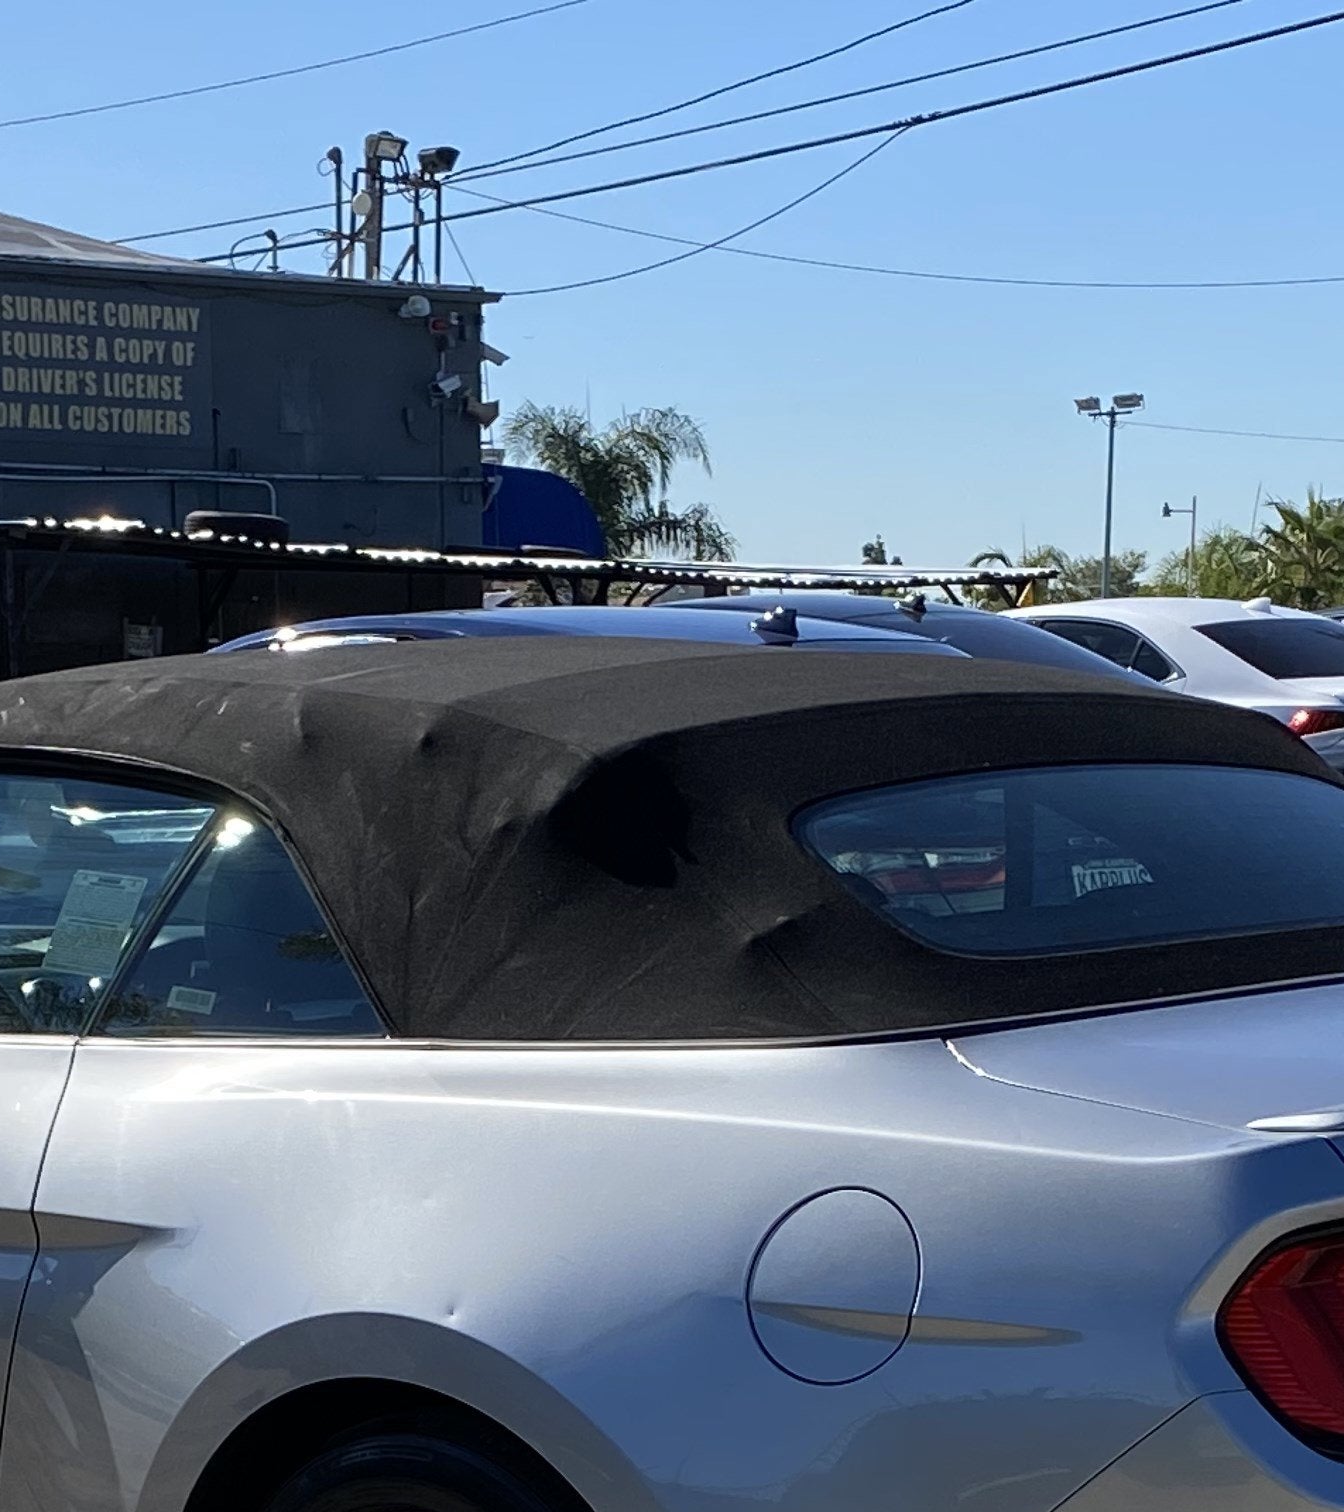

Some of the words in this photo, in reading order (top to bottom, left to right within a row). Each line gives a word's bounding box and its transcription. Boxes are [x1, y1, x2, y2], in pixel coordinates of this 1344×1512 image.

[104, 302, 200, 332] COMPANY
[95, 337, 107, 362] A
[113, 337, 166, 365] COPY
[171, 341, 195, 366] OF
[2, 367, 97, 396] DRIVER'S
[104, 372, 183, 401] LICENSE
[28, 404, 62, 430] ALL
[68, 405, 191, 435] CUSTOMERS
